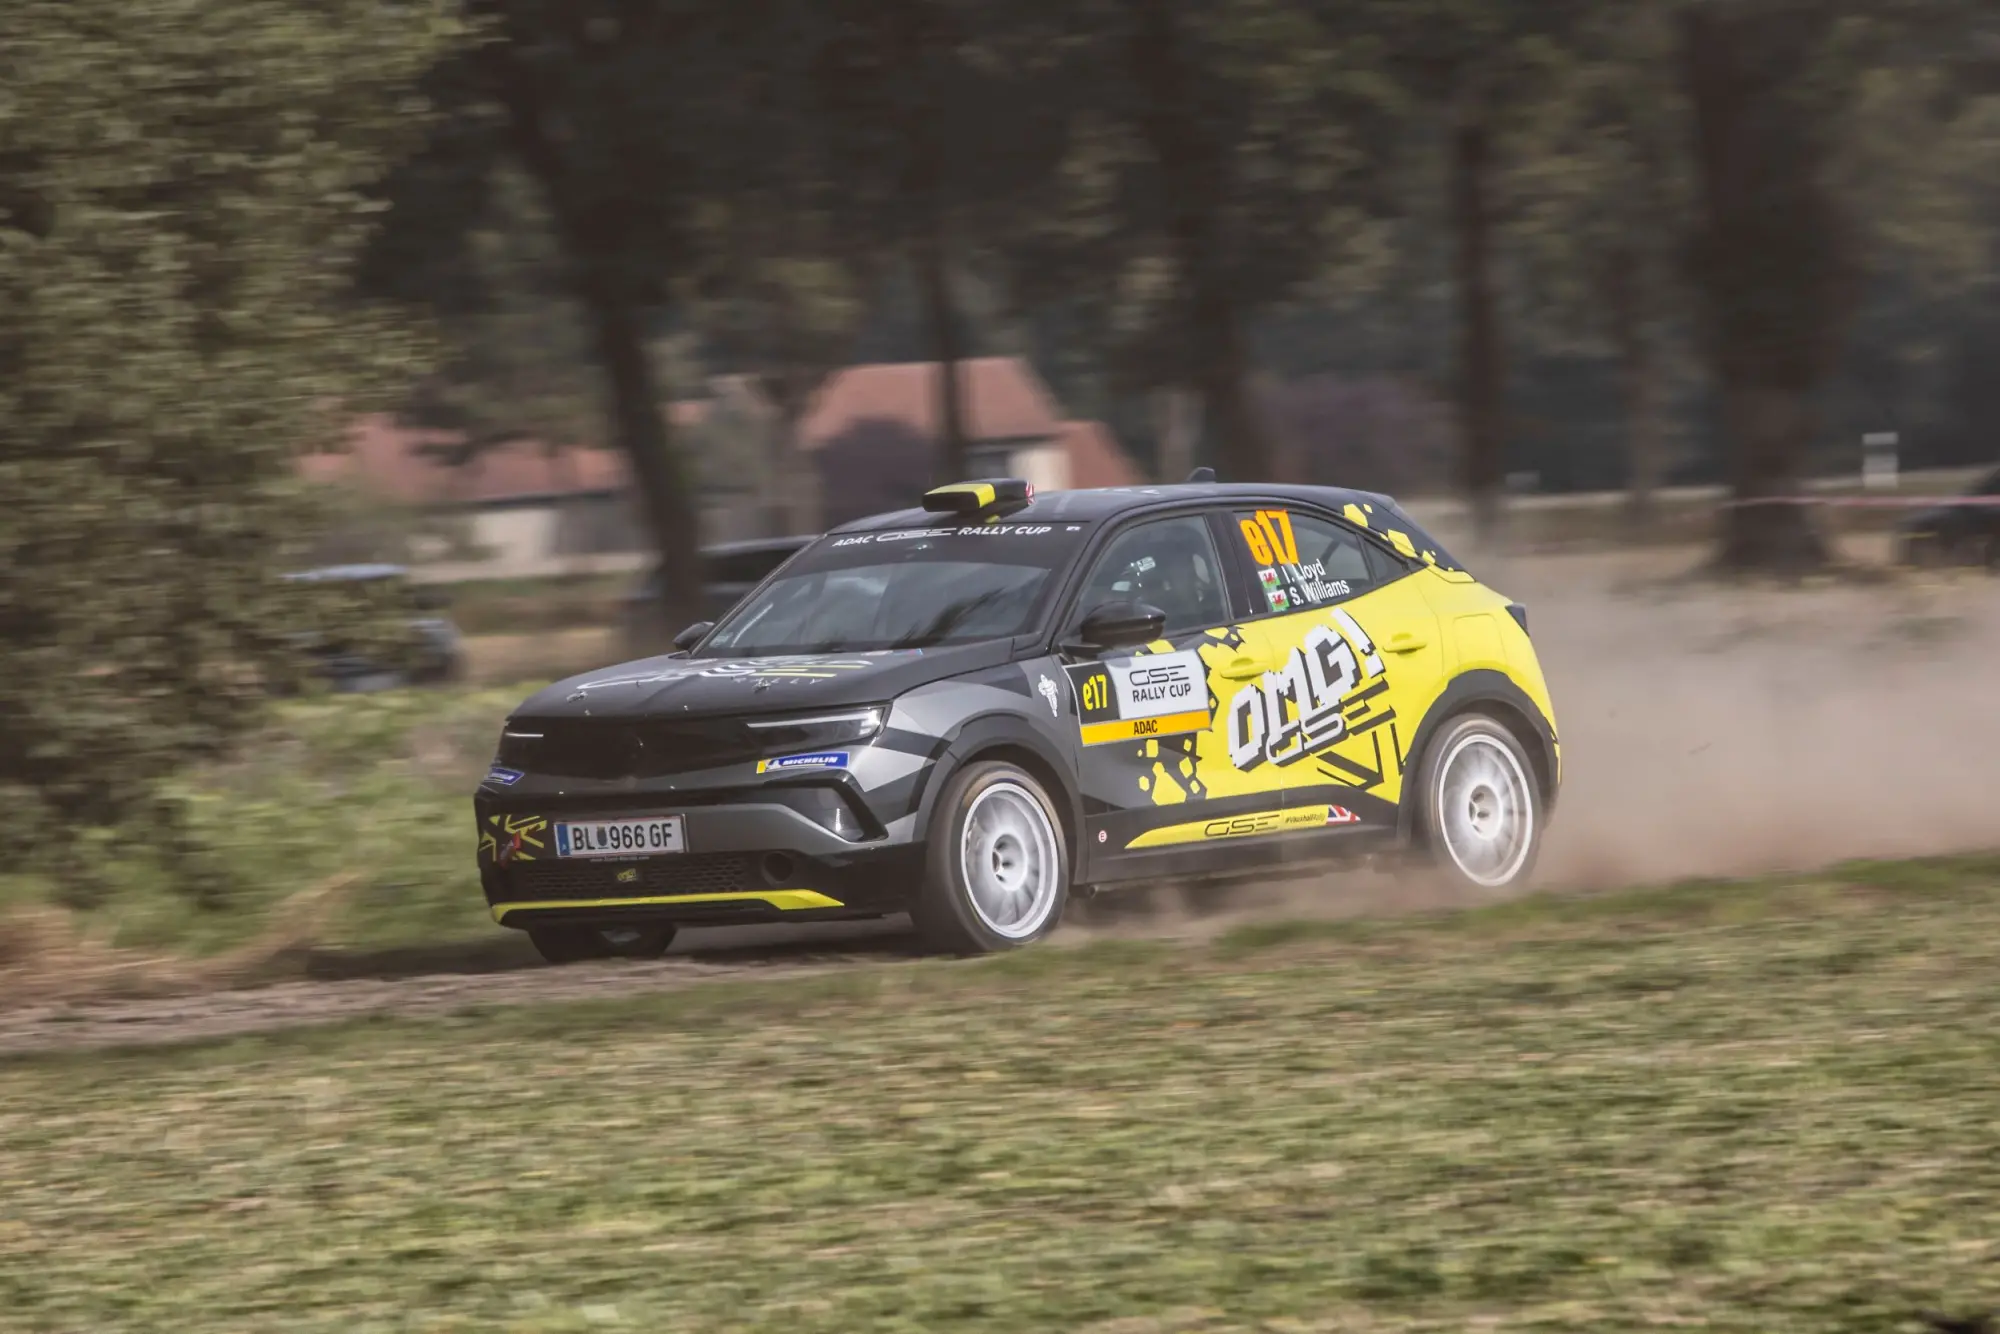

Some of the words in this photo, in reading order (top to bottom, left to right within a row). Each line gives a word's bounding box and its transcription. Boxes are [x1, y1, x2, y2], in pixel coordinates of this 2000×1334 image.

[832, 535, 874, 547] ADAC
[957, 526, 1014, 536] RALLY
[1014, 526, 1052, 535] CUP
[1240, 509, 1299, 566] e17
[1291, 558, 1326, 582] Lloyd
[1289, 586, 1304, 606] S.
[1301, 579, 1350, 603] Williams
[1129, 664, 1190, 687] GSE
[1082, 674, 1108, 711] e17
[1132, 686, 1166, 703] RALLY
[1169, 683, 1192, 698] CUP
[1228, 607, 1386, 773] OMG!
[1133, 719, 1158, 735] ADAC
[783, 756, 839, 766] MICHELIN
[572, 827, 595, 850] BL
[609, 820, 645, 849] 966
[649, 818, 672, 847] GF
[1204, 814, 1281, 837] GSE
